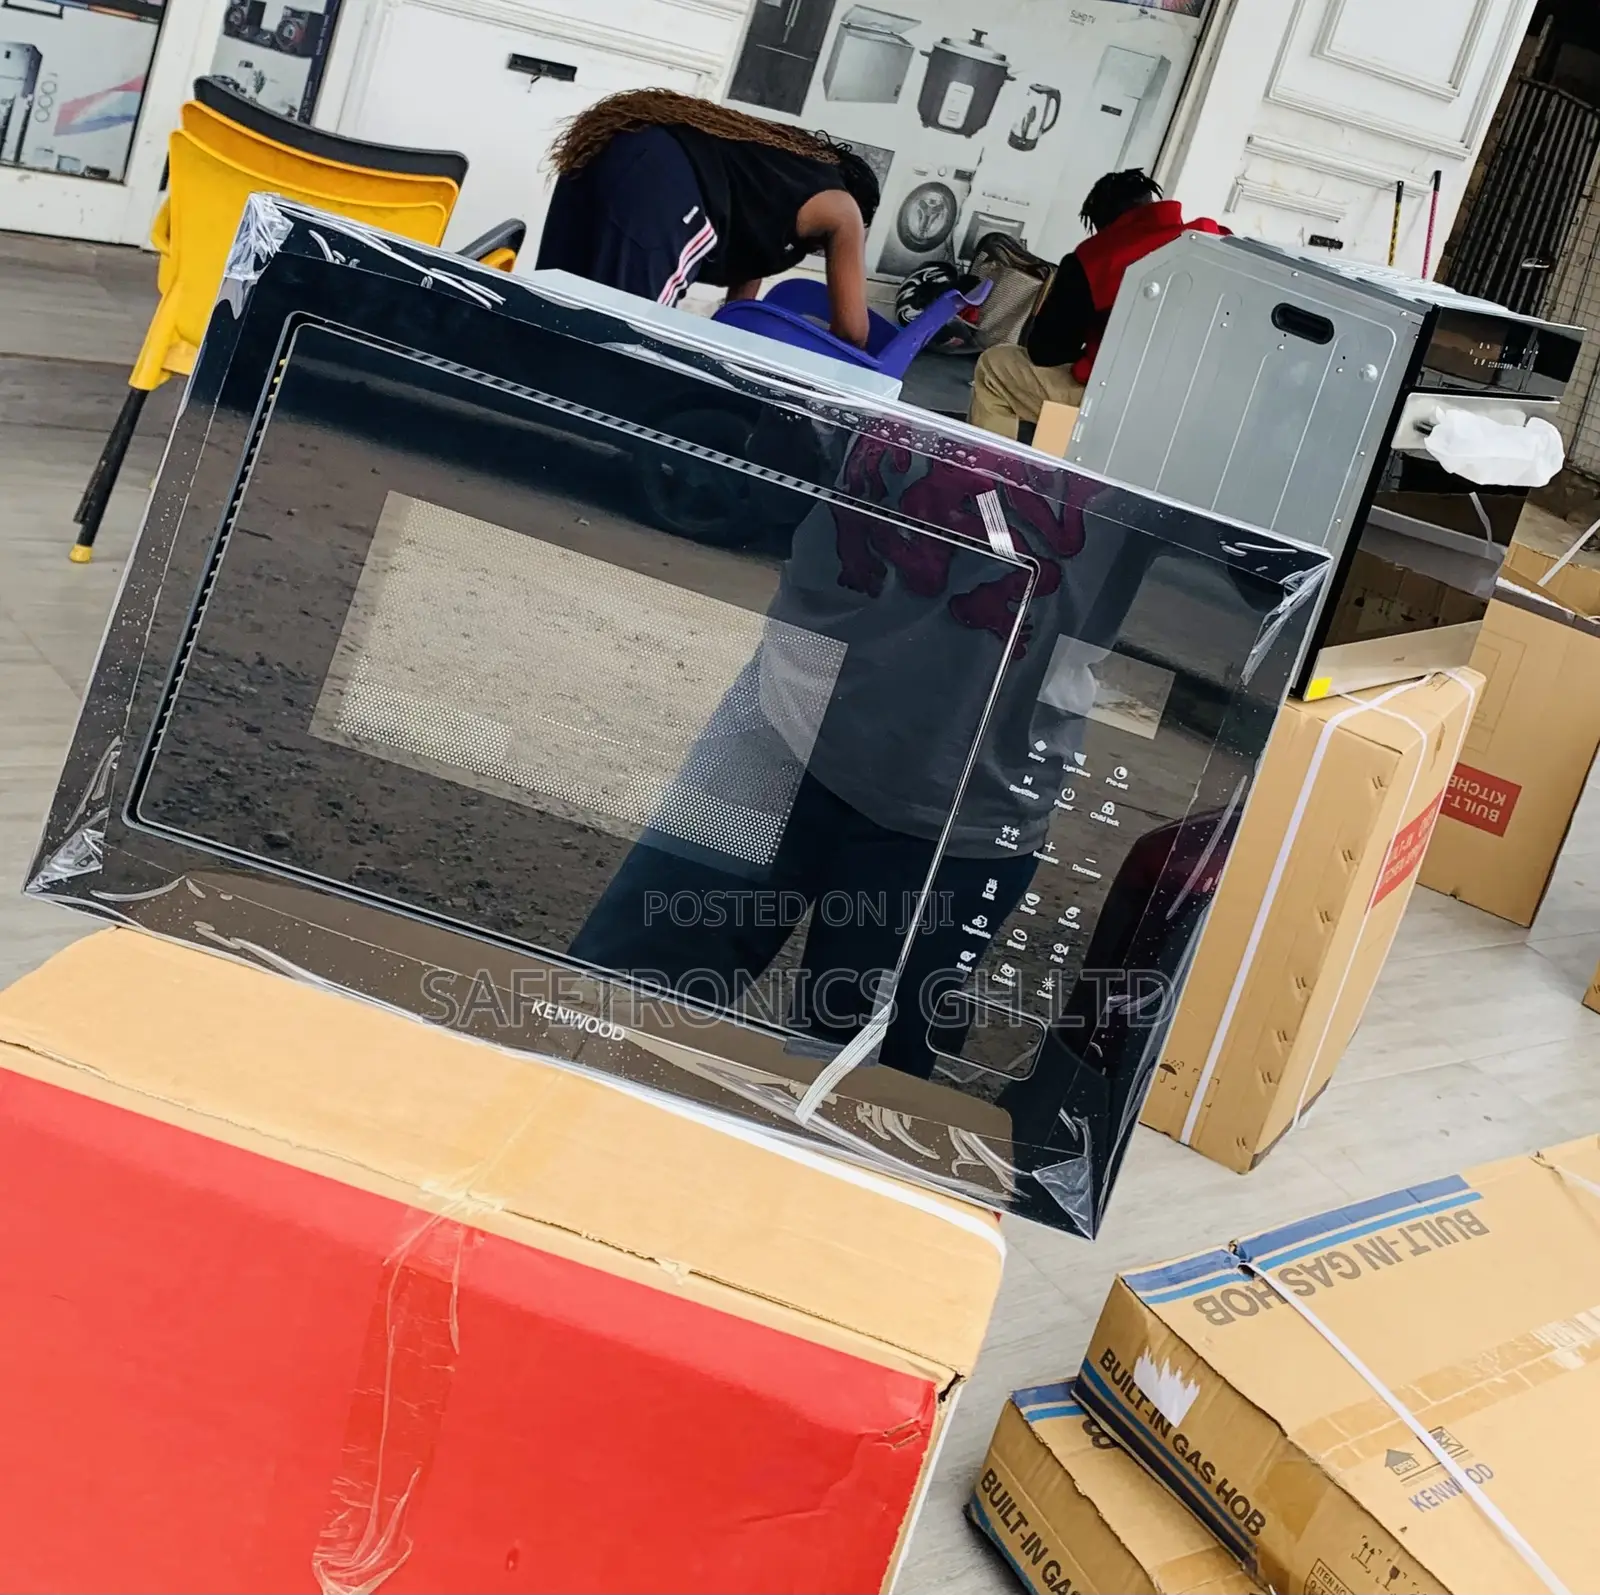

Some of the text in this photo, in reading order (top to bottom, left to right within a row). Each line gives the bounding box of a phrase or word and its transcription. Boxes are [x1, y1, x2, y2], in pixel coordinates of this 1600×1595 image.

[1053, 799, 1074, 811] Power
[1089, 811, 1120, 828] Child lock
[994, 837, 1018, 851] Defrost
[1032, 850, 1059, 865] Increase
[1072, 863, 1102, 879] Decrease
[1019, 904, 1037, 916] Soup
[1057, 916, 1081, 930] Noodle
[962, 923, 992, 940] Vegetable
[1049, 953, 1064, 964] Fish
[956, 962, 973, 973] Meat
[531, 1000, 625, 1042] KENWOOD
[1192, 1208, 1491, 1327] BUILT-IN GAS HOB
[1099, 1348, 1173, 1439] BUILT-IN
[1172, 1433, 1217, 1485] GAS
[1215, 1477, 1267, 1537] HOB
[1408, 1463, 1494, 1513] KENWOD
[980, 1468, 1081, 1595] BUILT-IN GA
